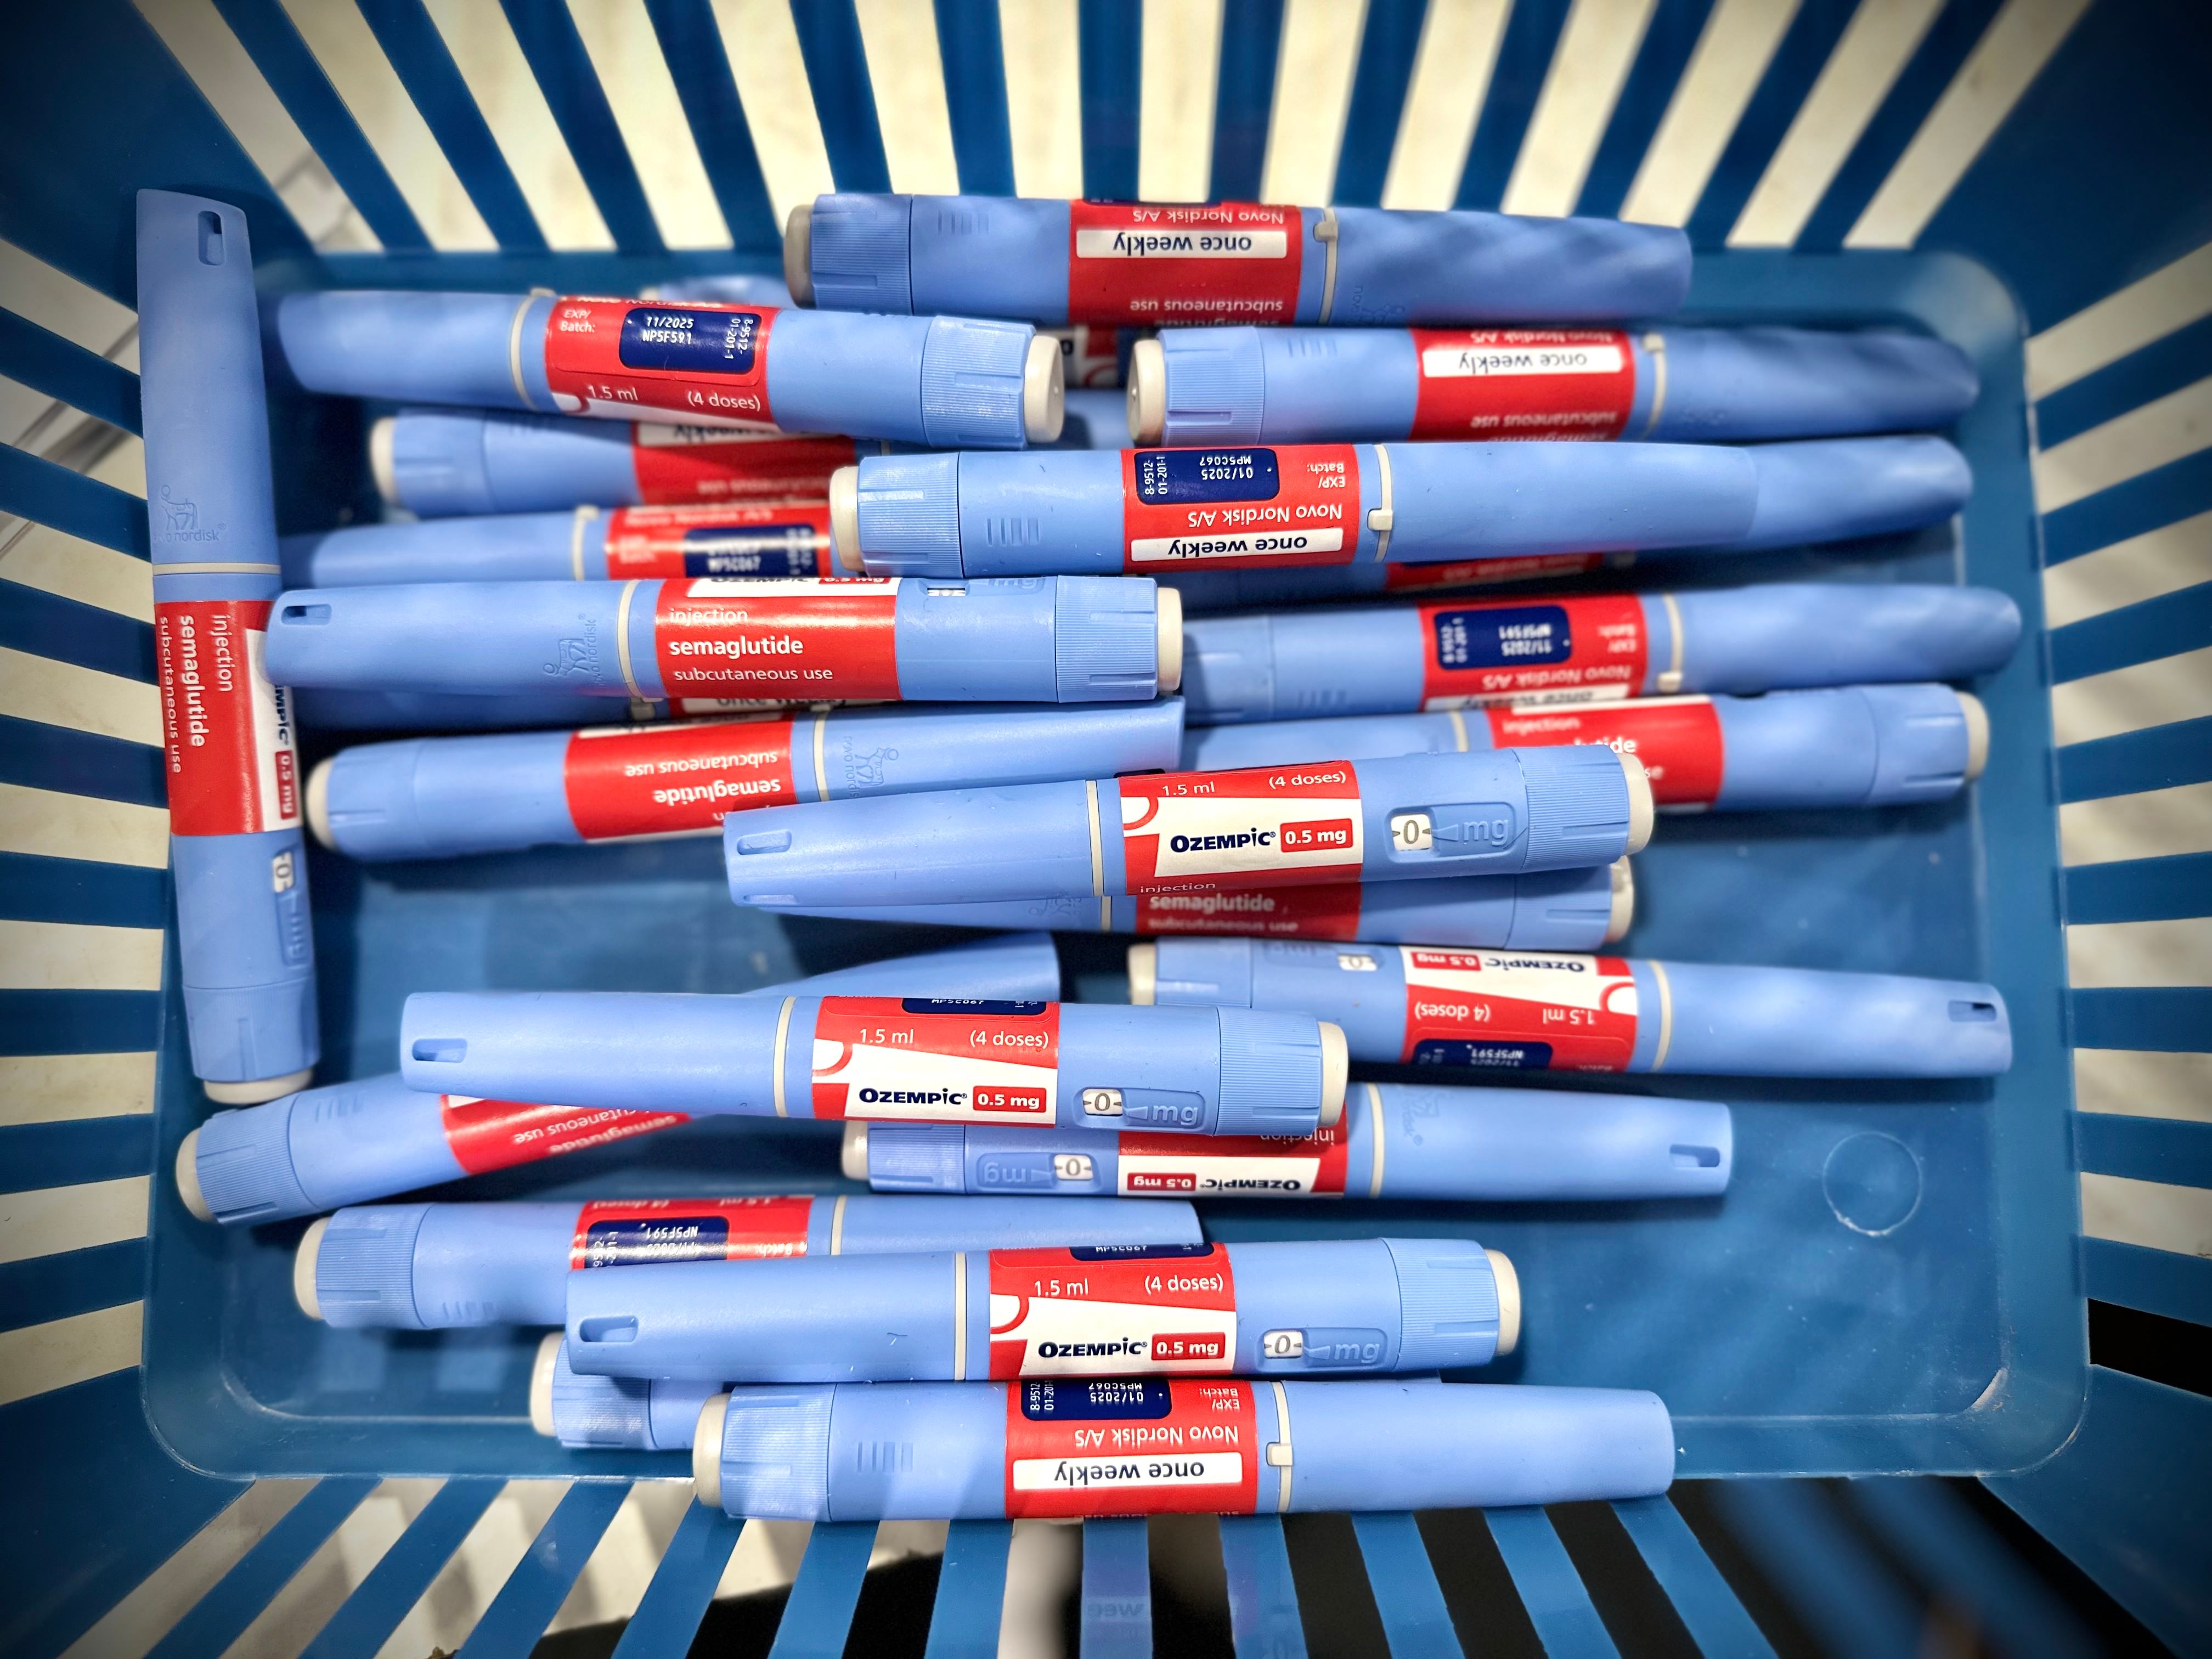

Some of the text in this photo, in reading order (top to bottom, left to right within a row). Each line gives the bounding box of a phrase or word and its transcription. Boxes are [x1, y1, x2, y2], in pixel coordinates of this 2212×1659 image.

[1133, 208, 1284, 224] Novo Nordisk A/S
[1113, 232, 1252, 257] once weekly
[1130, 298, 1283, 313] subcutaneous use
[564, 310, 591, 319] EXP/
[646, 317, 694, 329] 11/2025
[561, 321, 596, 333] Batch:
[642, 330, 692, 345] NP5F591
[1459, 353, 1587, 374] once weekly
[588, 386, 639, 400] 1.5 ml
[688, 391, 760, 411] (4 doses)
[1199, 456, 1251, 465] MP5C067
[1306, 462, 1345, 472] Batch:
[1144, 460, 1154, 495] 8-9512-
[1157, 456, 1168, 494] 01-201-1
[1201, 467, 1254, 479] 01/2025
[1318, 476, 1345, 489] EXP/
[1188, 504, 1342, 527] Novo Nordisk A/S
[1167, 537, 1307, 558] once weekly
[670, 608, 748, 624] injection
[210, 614, 233, 692] injection
[669, 635, 803, 660] semaglutide
[179, 615, 210, 747] semaglutide
[674, 668, 833, 681] subcutaneous use
[160, 617, 181, 773] subcutaneous use
[279, 754, 292, 781] 0.5
[625, 751, 777, 777] subcutaneous use
[844, 765, 860, 798] nordis
[1268, 771, 1346, 789] (4 doses)
[653, 780, 781, 806] semaglutide
[1162, 781, 1215, 797] 1.5 ml
[281, 786, 293, 814] mg
[1285, 830, 1312, 844] 0.5
[1317, 829, 1346, 844] mg
[1403, 820, 1508, 847] 0 mg
[1140, 882, 1216, 894] injection
[1149, 894, 1275, 913] semaglutide
[1416, 953, 1446, 966] mg
[1451, 954, 1476, 967] 0.5
[1414, 1001, 1491, 1022] (4 doses)
[1542, 1008, 1595, 1025] 1.5 ml
[859, 1028, 913, 1044] 1.5 ml
[969, 1031, 1049, 1049] (4 doses)
[977, 1094, 1006, 1106] 0.5
[1010, 1095, 1040, 1109] mg
[1094, 1093, 1198, 1126] 0 mg
[1065, 1158, 1081, 1176] 0
[1134, 1176, 1161, 1187] mg
[1166, 1179, 1192, 1187] 0.5
[645, 1226, 698, 1239] NP5F591
[1035, 1278, 1089, 1296] 1.5 ml
[1144, 1273, 1223, 1295] (4 doses)
[1156, 1341, 1183, 1355] 0.5
[1189, 1341, 1218, 1355] mg
[1274, 1335, 1379, 1363] 0 mg
[1090, 1391, 1143, 1403] 01/2025
[1199, 1388, 1237, 1397] Batch:
[1211, 1398, 1240, 1410] EXP/
[1075, 1426, 1238, 1447] Novo Nordisk A/S
[1054, 1462, 1204, 1486] once weekly
